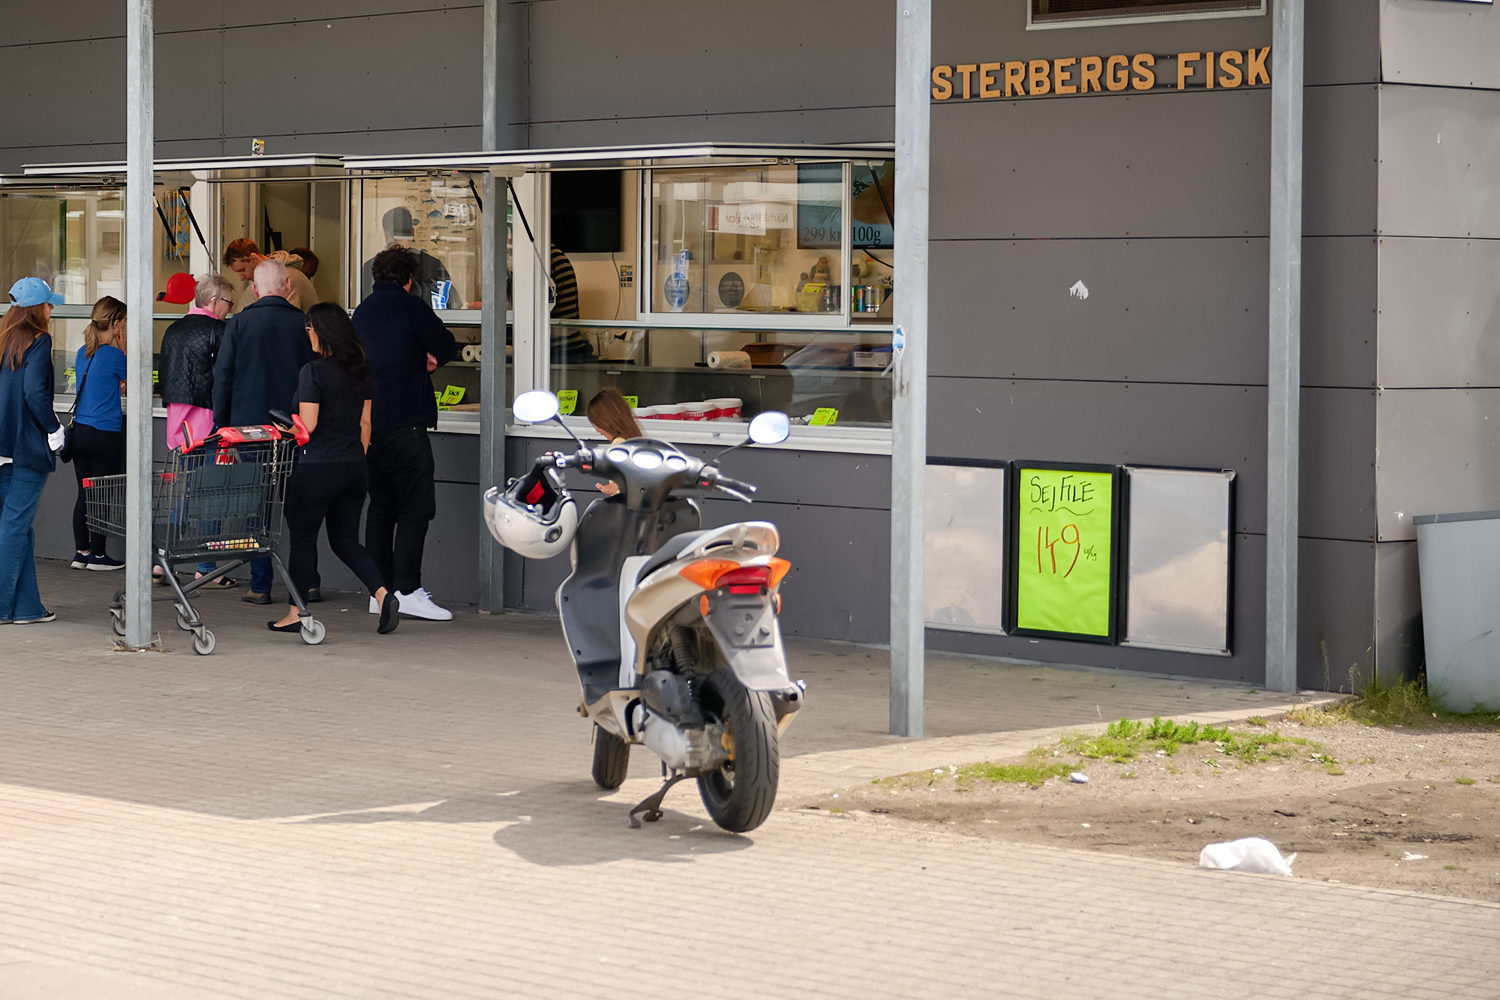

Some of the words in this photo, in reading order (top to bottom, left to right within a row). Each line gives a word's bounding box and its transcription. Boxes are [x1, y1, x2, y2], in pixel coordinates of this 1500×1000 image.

[931, 53, 1156, 100] STERBERGS
[1177, 47, 1271, 90] FISK
[803, 226, 826, 242] 299
[1037, 523, 1081, 579] 149
